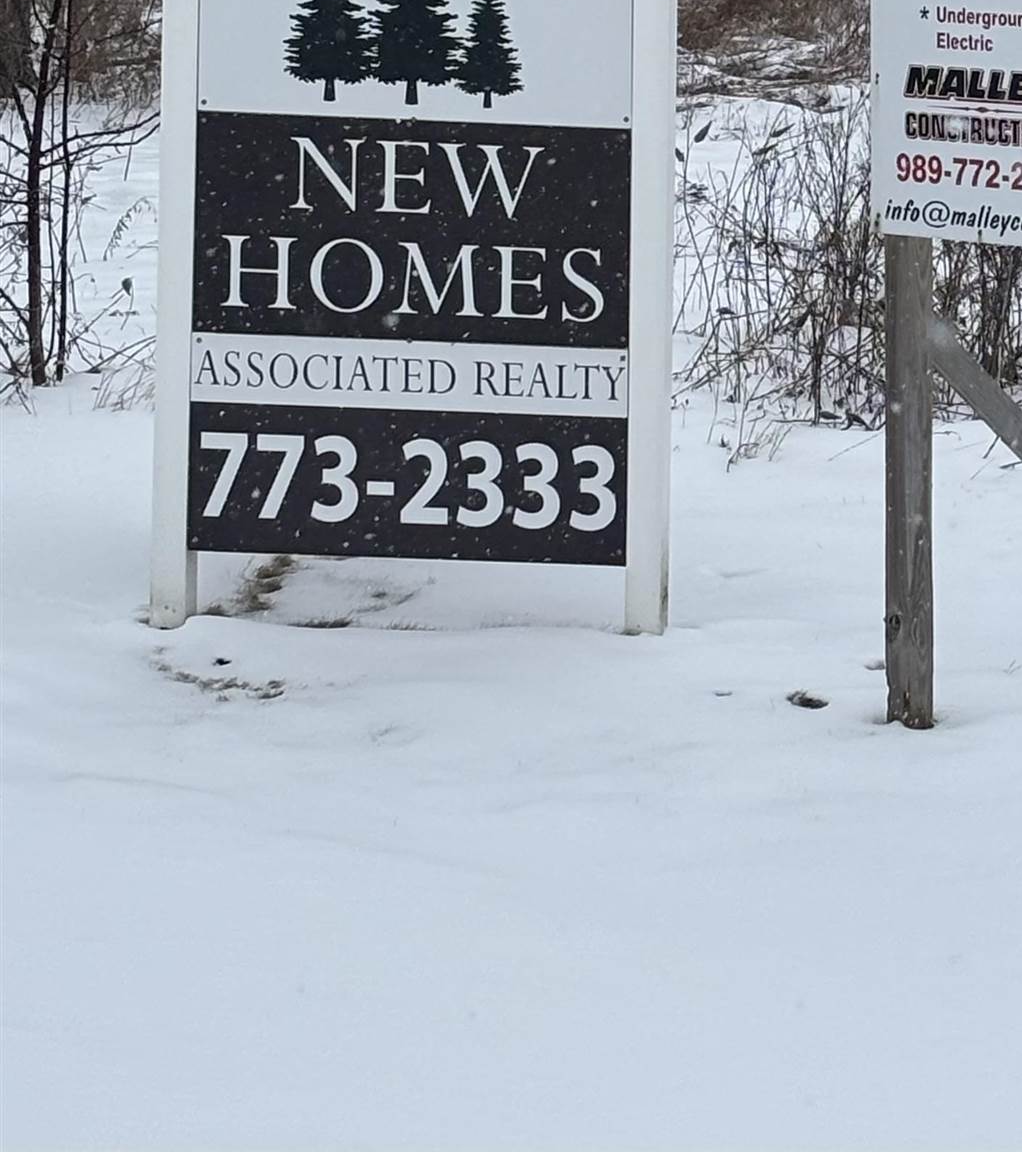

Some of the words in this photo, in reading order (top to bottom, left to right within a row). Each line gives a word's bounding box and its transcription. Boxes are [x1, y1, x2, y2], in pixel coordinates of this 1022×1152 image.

[936, 32, 993, 52] Electric
[290, 136, 545, 218] NEW
[221, 235, 604, 323] HOMES
[194, 350, 456, 394] ASSOCIATED
[474, 361, 625, 402] REALTY
[200, 432, 616, 531] 773-2333
